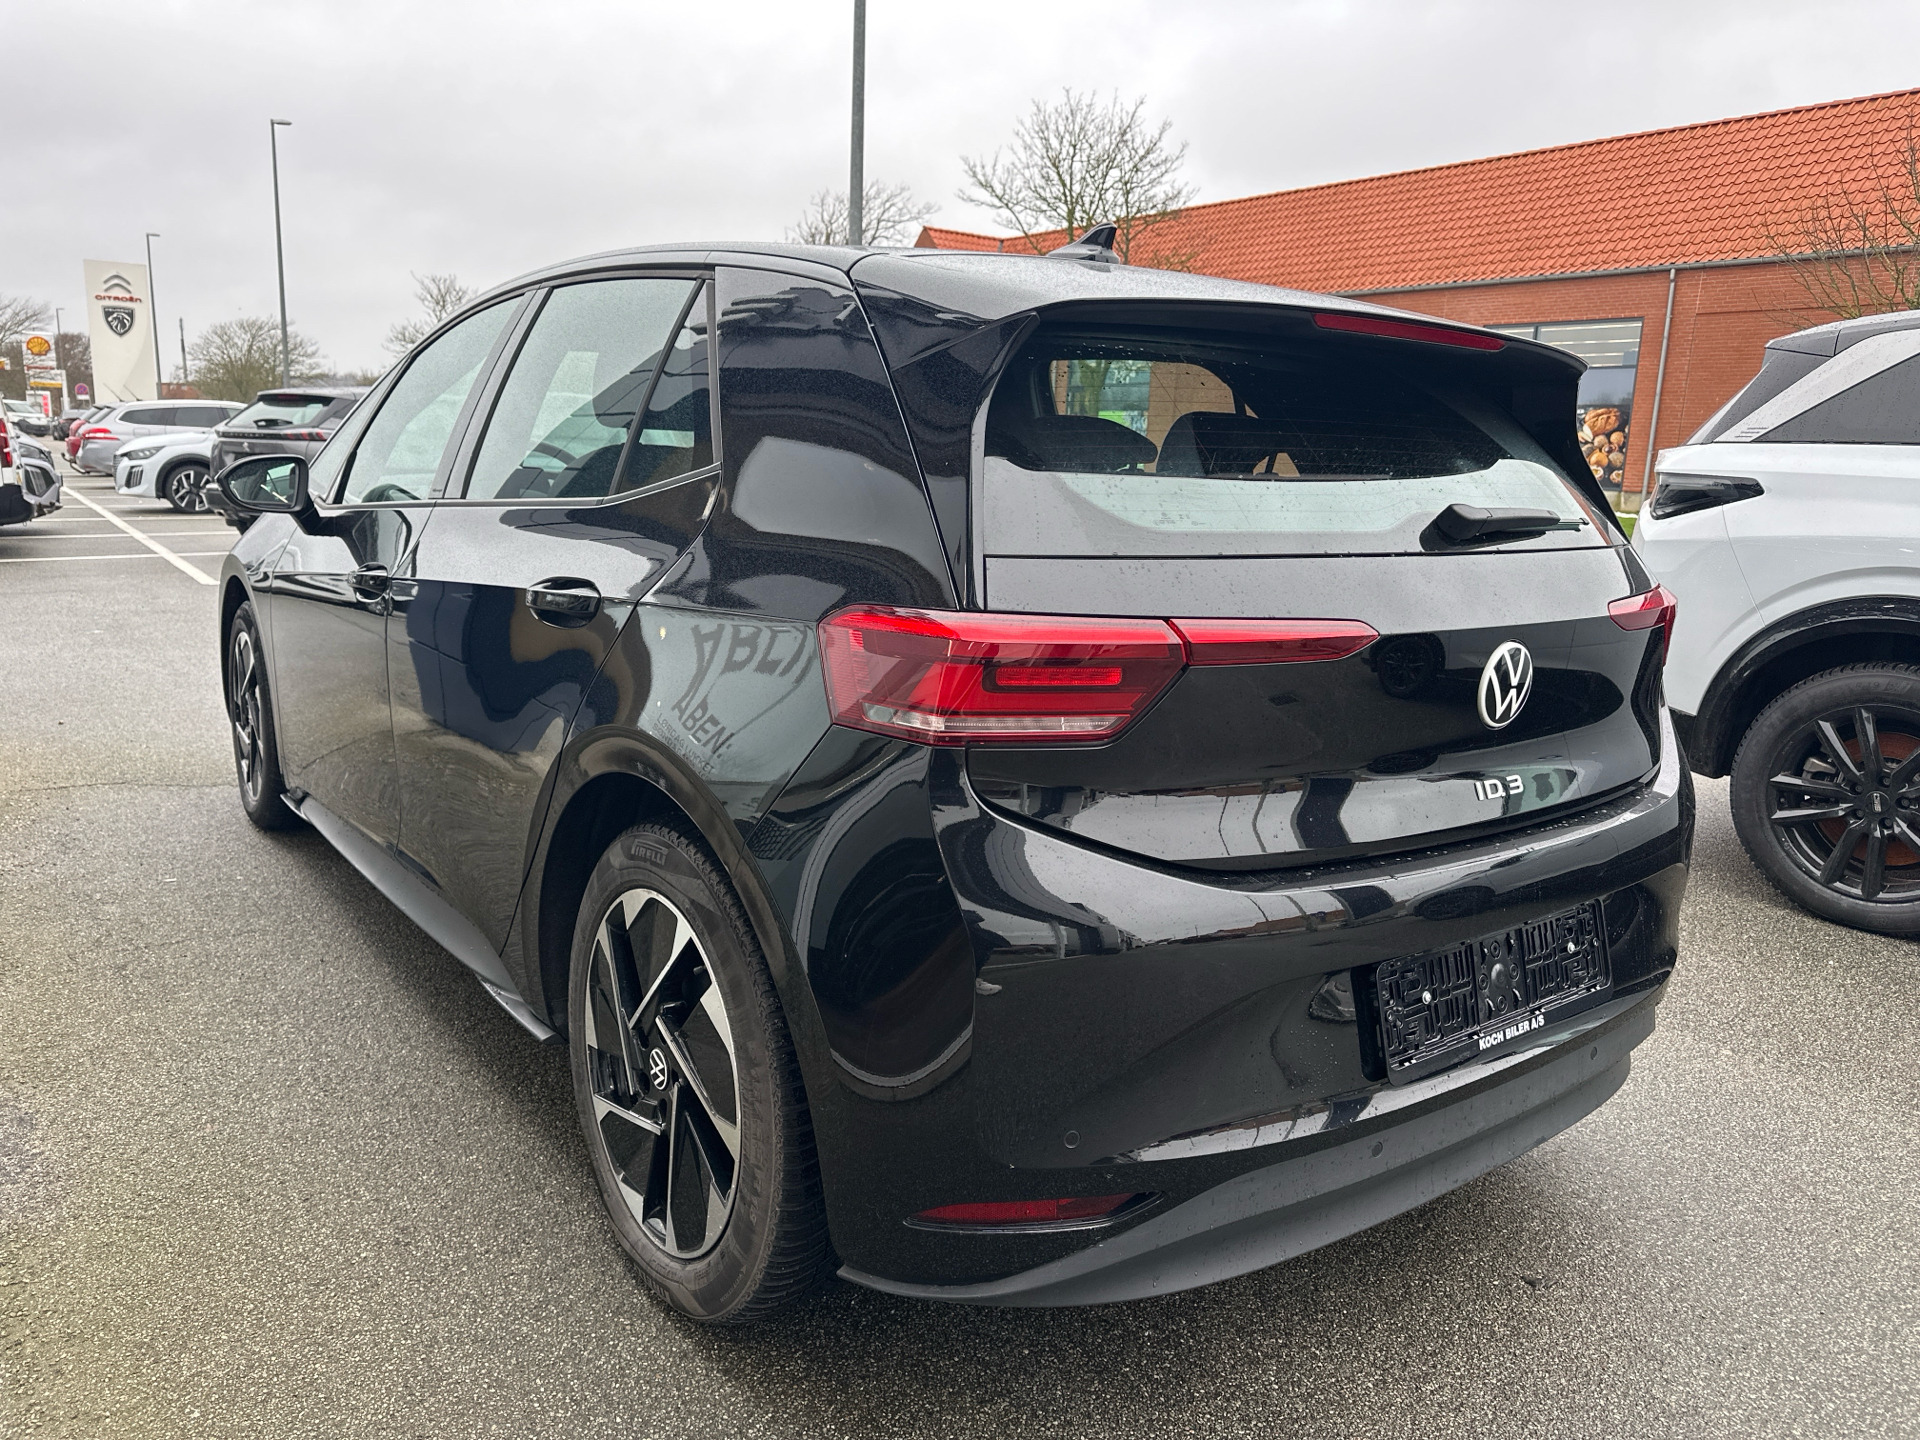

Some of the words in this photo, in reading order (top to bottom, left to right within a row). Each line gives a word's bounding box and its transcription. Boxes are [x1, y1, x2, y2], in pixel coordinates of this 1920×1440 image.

[631, 838, 669, 866] PIRELLI
[1478, 1030, 1504, 1051] KOCH
[1505, 1020, 1530, 1040] BILER
[1530, 1014, 1545, 1031] A/S
